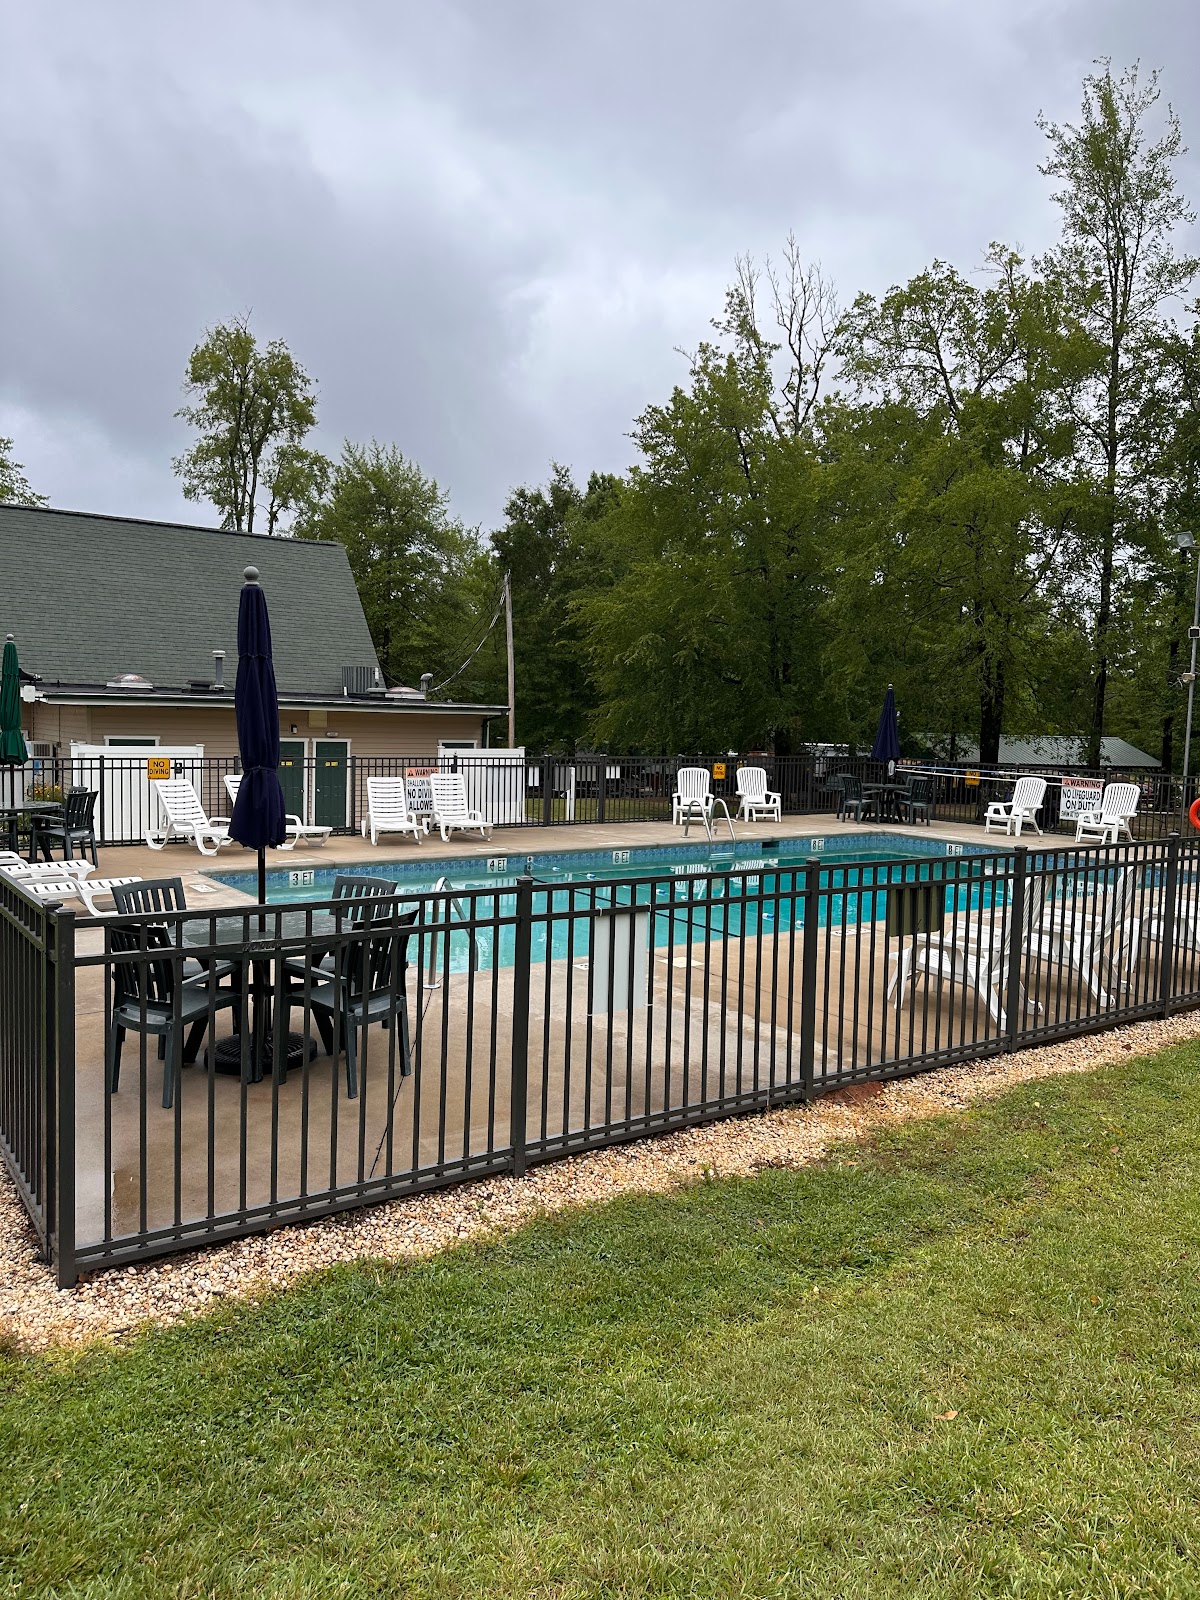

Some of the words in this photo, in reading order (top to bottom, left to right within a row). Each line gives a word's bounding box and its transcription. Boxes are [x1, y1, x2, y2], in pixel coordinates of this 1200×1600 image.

[415, 768, 438, 776] WARNING
[407, 779, 426, 787] SHALLOW
[1070, 779, 1101, 788] WARNING
[407, 788, 416, 799] NO
[418, 788, 433, 799] DIVIN
[1062, 789, 1071, 799] NO
[1072, 790, 1101, 801] LIFEGUARD
[409, 800, 433, 811] ALLOWE
[1065, 800, 1077, 810] ON
[1078, 801, 1096, 811] DUTY
[948, 844, 953, 855] 8
[489, 859, 495, 871] 4
[292, 872, 299, 885] 3
